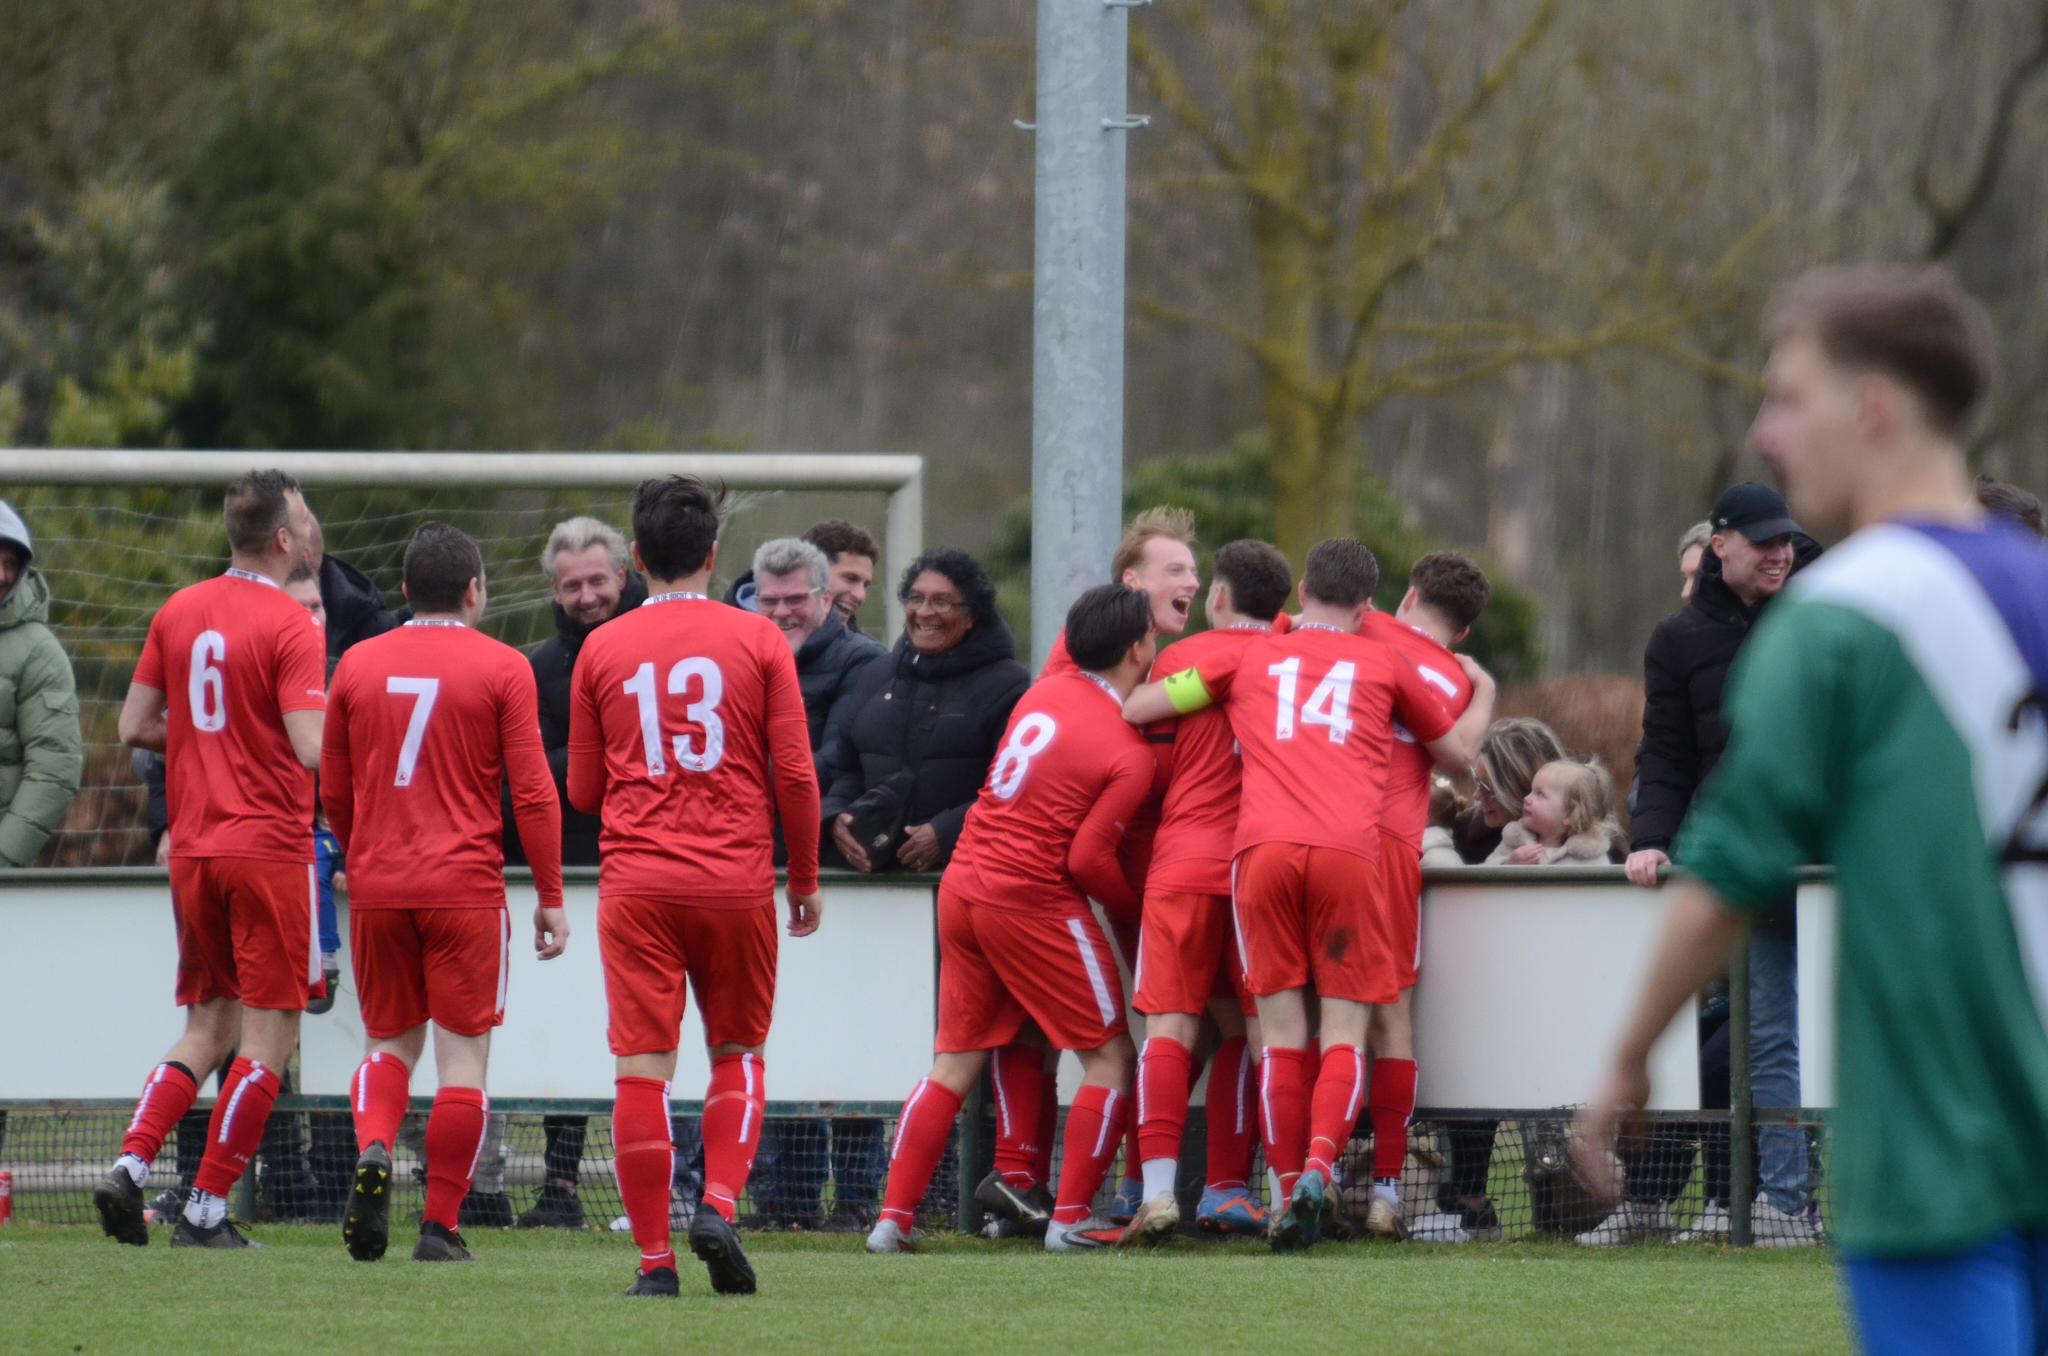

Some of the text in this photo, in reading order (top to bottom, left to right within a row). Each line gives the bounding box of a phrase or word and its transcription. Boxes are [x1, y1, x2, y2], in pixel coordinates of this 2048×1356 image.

[188, 630, 227, 732] 6
[623, 656, 724, 776] 13
[1268, 657, 1355, 745] 14
[386, 676, 440, 787] 7
[990, 712, 1056, 799] 8
[232, 1152, 249, 1164] JAK
